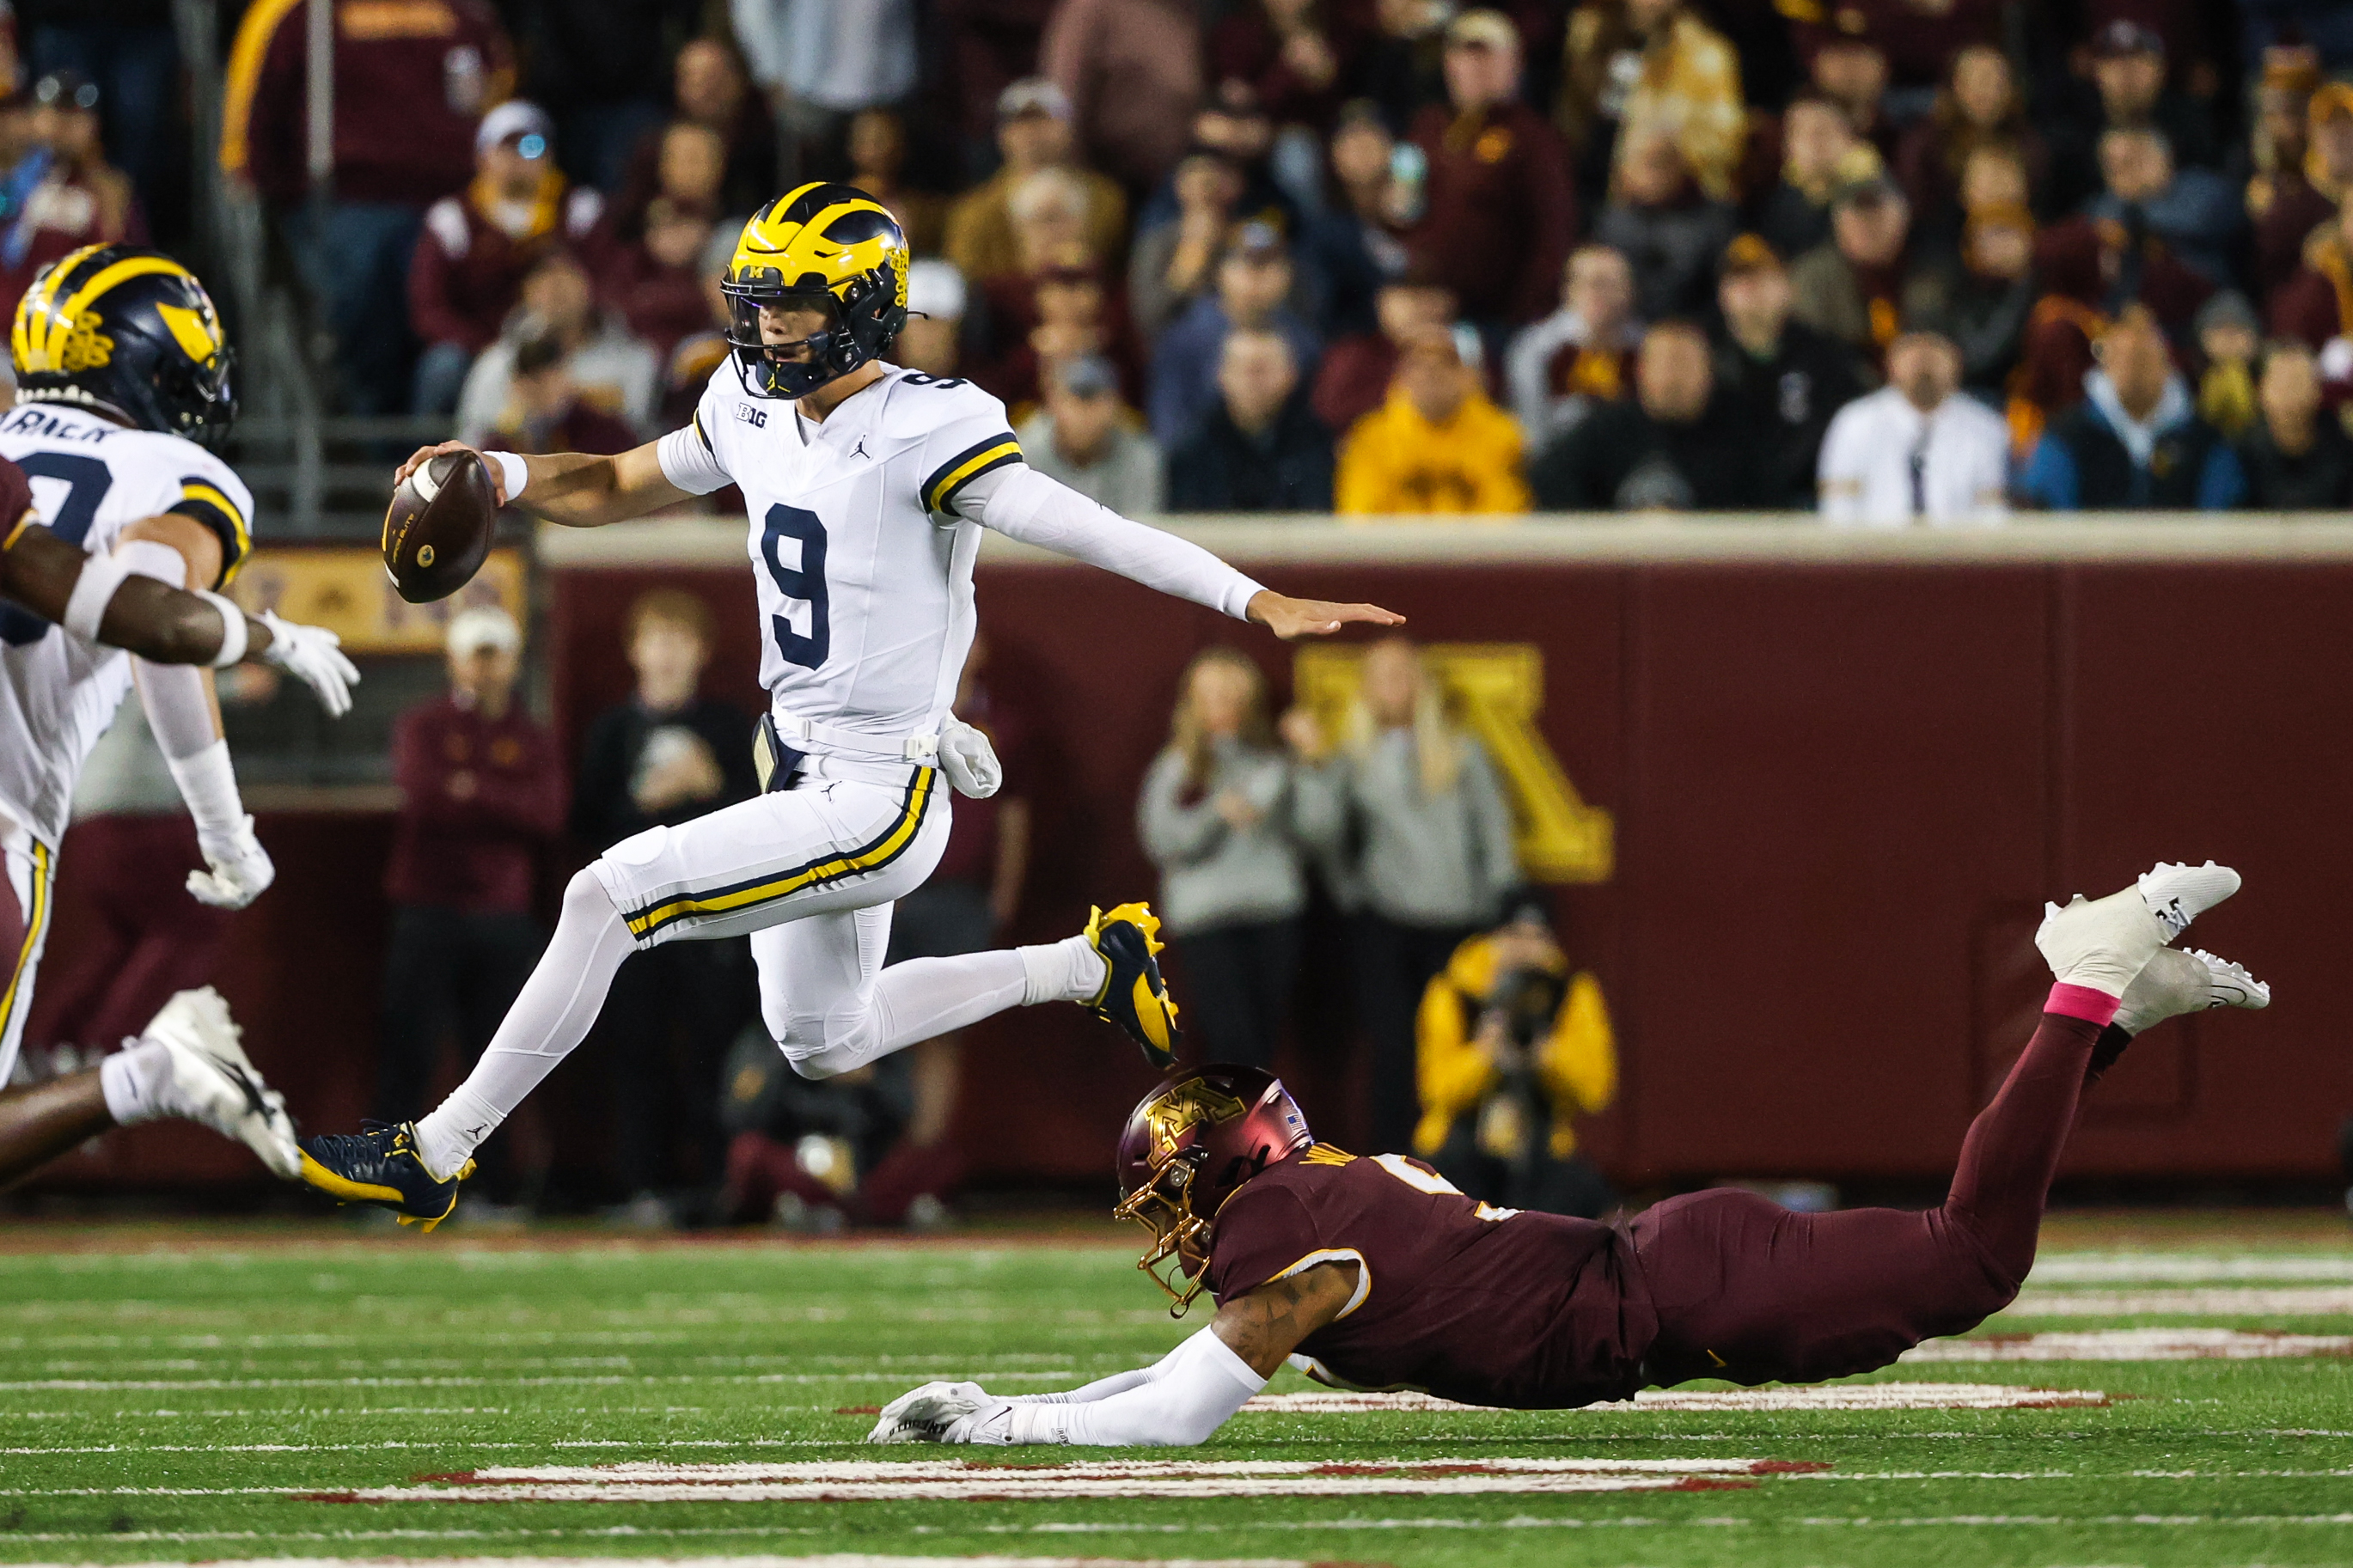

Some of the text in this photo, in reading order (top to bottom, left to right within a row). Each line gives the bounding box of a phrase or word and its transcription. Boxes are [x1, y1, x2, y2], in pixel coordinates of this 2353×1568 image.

[748, 265, 765, 278] M
[761, 502, 830, 671] 9
[1143, 1076, 1246, 1169] M
